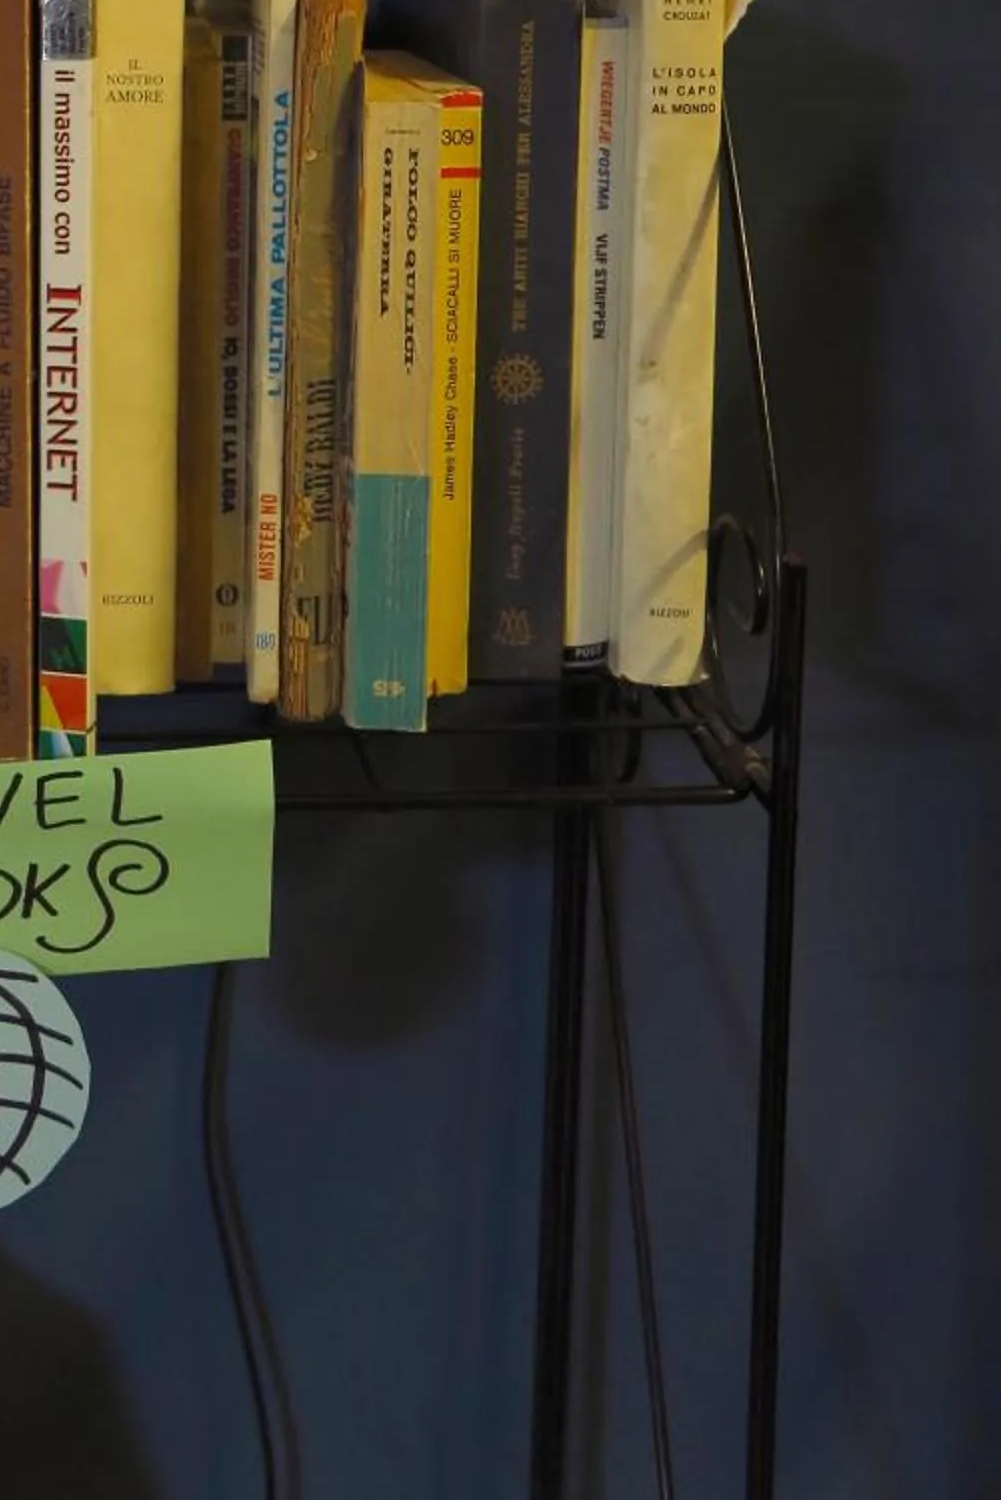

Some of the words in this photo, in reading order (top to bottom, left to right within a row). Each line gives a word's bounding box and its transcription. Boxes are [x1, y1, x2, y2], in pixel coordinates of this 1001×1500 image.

[54, 69, 76, 83] il
[105, 73, 165, 86] NOSTRO
[127, 59, 143, 71] IL
[652, 67, 719, 80] L'ISOLA
[105, 89, 165, 105] AMORE
[651, 103, 668, 115] AL
[671, 103, 717, 116] MONDO
[652, 85, 668, 97] IN
[676, 85, 717, 98] CAPO
[54, 93, 76, 203] massimo
[441, 129, 475, 146] 309
[270, 90, 291, 265] PALLOTTOLA
[406, 147, 420, 242] FOLCO
[596, 147, 612, 211] POSTMA
[54, 211, 73, 256] con
[380, 147, 394, 317] GIRATERRA
[448, 188, 462, 244] MUORE
[448, 248, 461, 264] SI
[594, 233, 610, 265] VIJF
[446, 268, 461, 343] SCIACALLI
[592, 268, 609, 340] STRIPPEN
[221, 337, 239, 360] IO,
[267, 277, 287, 397] L'ULTIMA
[46, 283, 83, 503] INTERNET
[222, 366, 239, 419] BOSSI
[444, 357, 459, 400] Chase
[222, 424, 238, 435] E
[444, 406, 463, 451] Hadley
[221, 440, 239, 463] LA
[221, 468, 238, 515] LEGA
[442, 456, 457, 501] James
[258, 493, 279, 515] NO
[256, 523, 278, 581] MISTER
